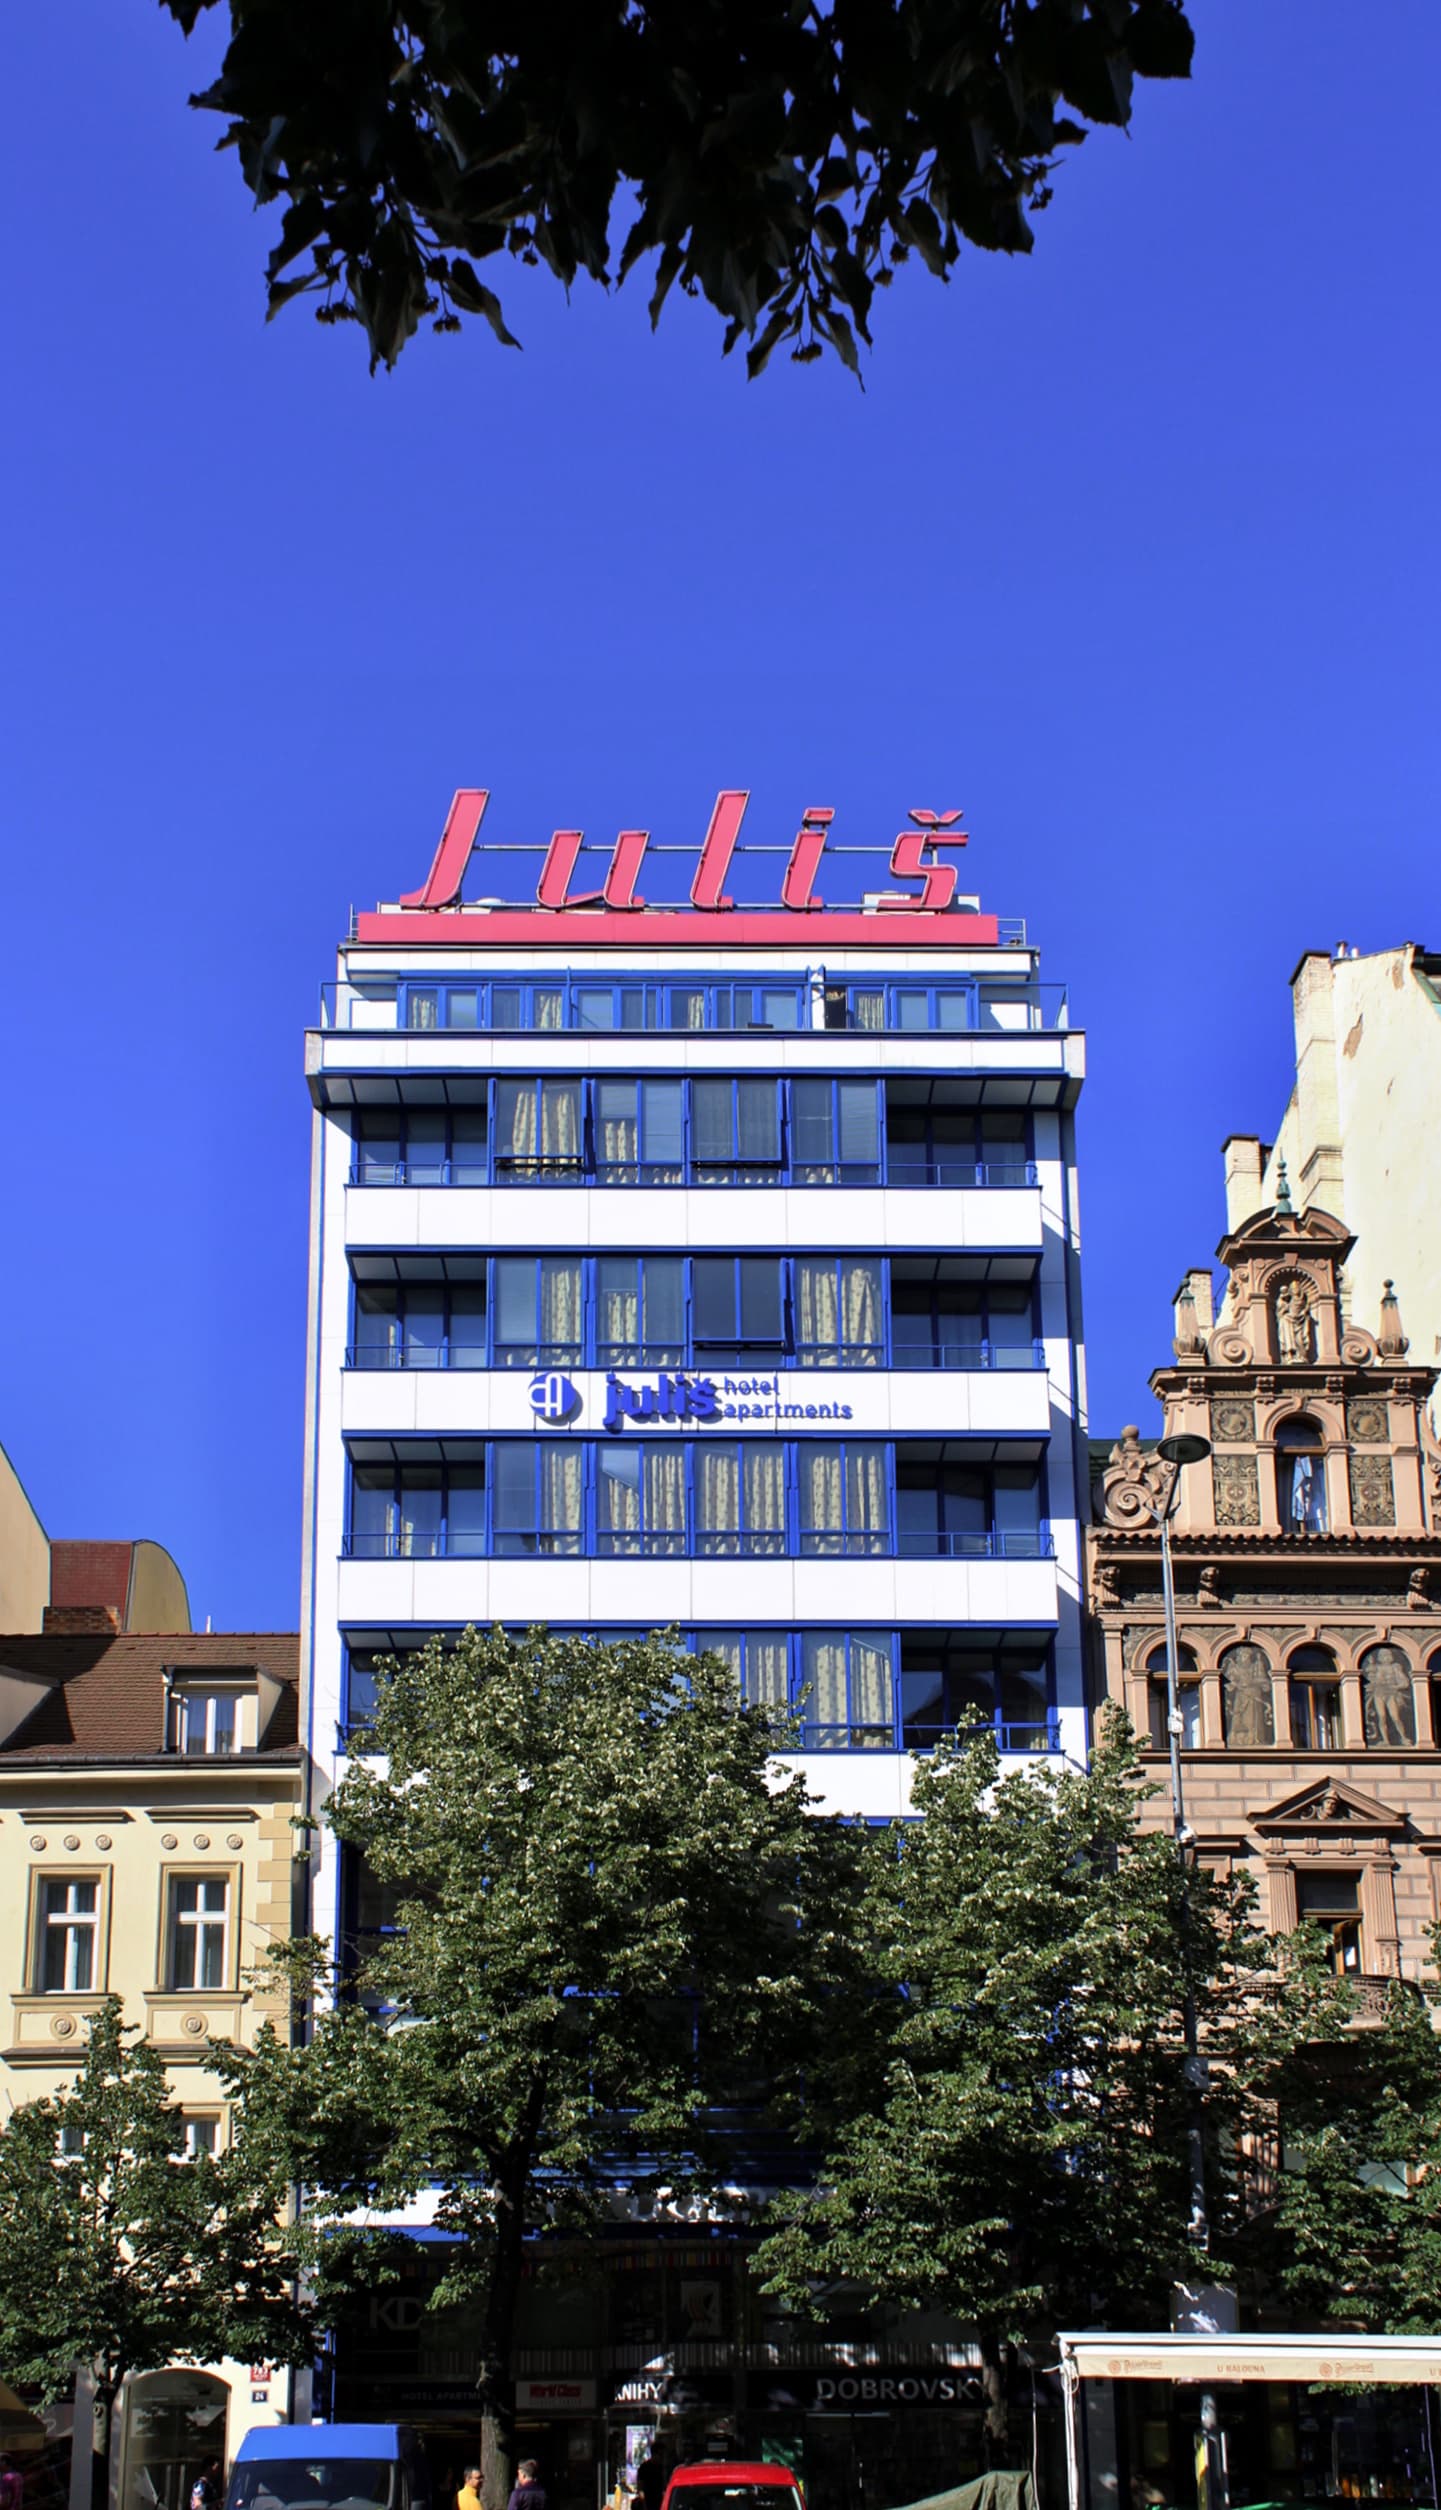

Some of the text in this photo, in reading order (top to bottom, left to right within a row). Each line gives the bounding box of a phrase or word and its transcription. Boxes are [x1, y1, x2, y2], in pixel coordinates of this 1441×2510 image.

[724, 1376, 779, 1395] hotel
[603, 1371, 717, 1425] juliš
[723, 1401, 853, 1422] apartments
[614, 2382, 663, 2401] KNIHY
